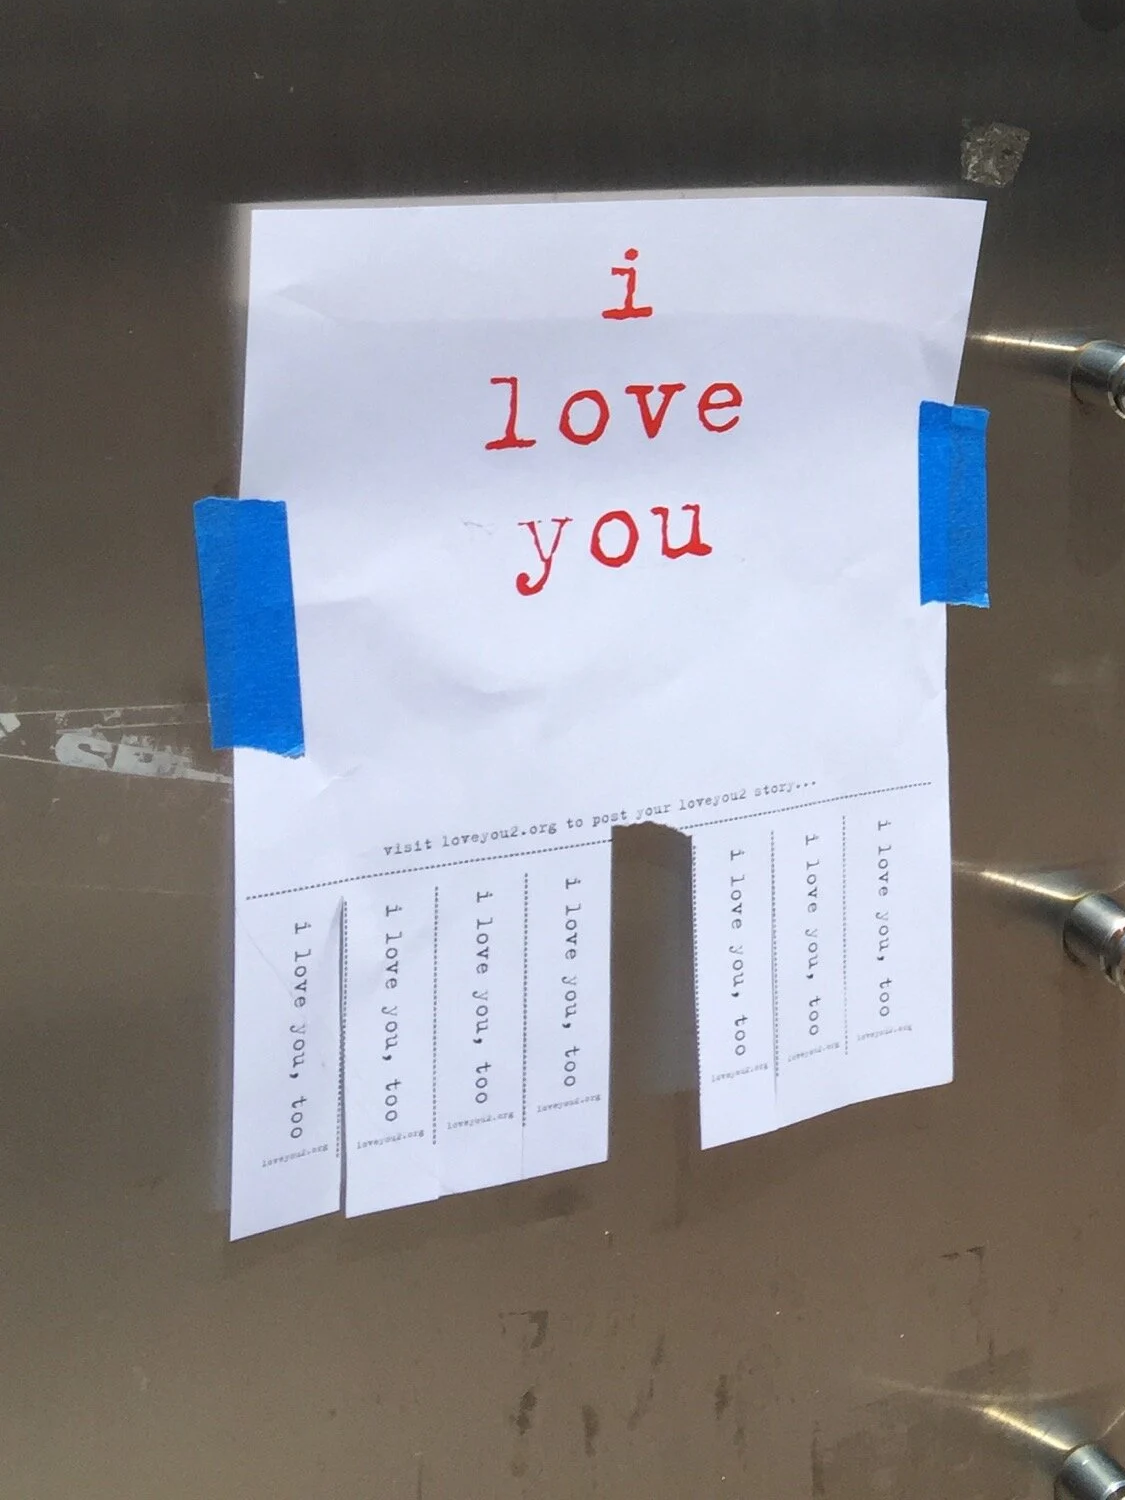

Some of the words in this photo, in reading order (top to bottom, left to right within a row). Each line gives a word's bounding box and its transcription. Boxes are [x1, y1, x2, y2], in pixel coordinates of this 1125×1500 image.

[602, 248, 653, 321] i
[486, 376, 744, 451] love
[516, 503, 713, 597] you
[383, 837, 433, 857] visit
[441, 819, 558, 848] loveyou2.org
[566, 816, 584, 829] to
[592, 807, 628, 827] post
[636, 802, 672, 820] your
[678, 788, 747, 812] loveyou2
[753, 779, 817, 798] story...
[804, 833, 820, 849] i
[877, 819, 893, 835] i
[729, 848, 747, 864] i
[876, 845, 893, 898] love
[384, 903, 404, 919] i
[474, 890, 494, 906] i
[564, 877, 583, 893] i
[729, 874, 746, 930] love
[805, 859, 822, 914] love
[291, 921, 313, 937] i
[475, 917, 494, 975] love
[564, 903, 583, 961] love
[804, 927, 820, 982] you,
[874, 910, 891, 963] you,
[289, 949, 313, 1009] love
[383, 931, 404, 990] love
[727, 943, 745, 1000] you,
[471, 989, 489, 1046] you,
[560, 974, 578, 1030] you,
[807, 994, 823, 1038] too
[878, 976, 893, 1019] too
[288, 1021, 309, 1082] you,
[380, 1004, 401, 1063] you,
[733, 1013, 749, 1058] too
[474, 1059, 493, 1106] too
[562, 1044, 581, 1089] too
[287, 1094, 309, 1141] too
[384, 1077, 403, 1124] too
